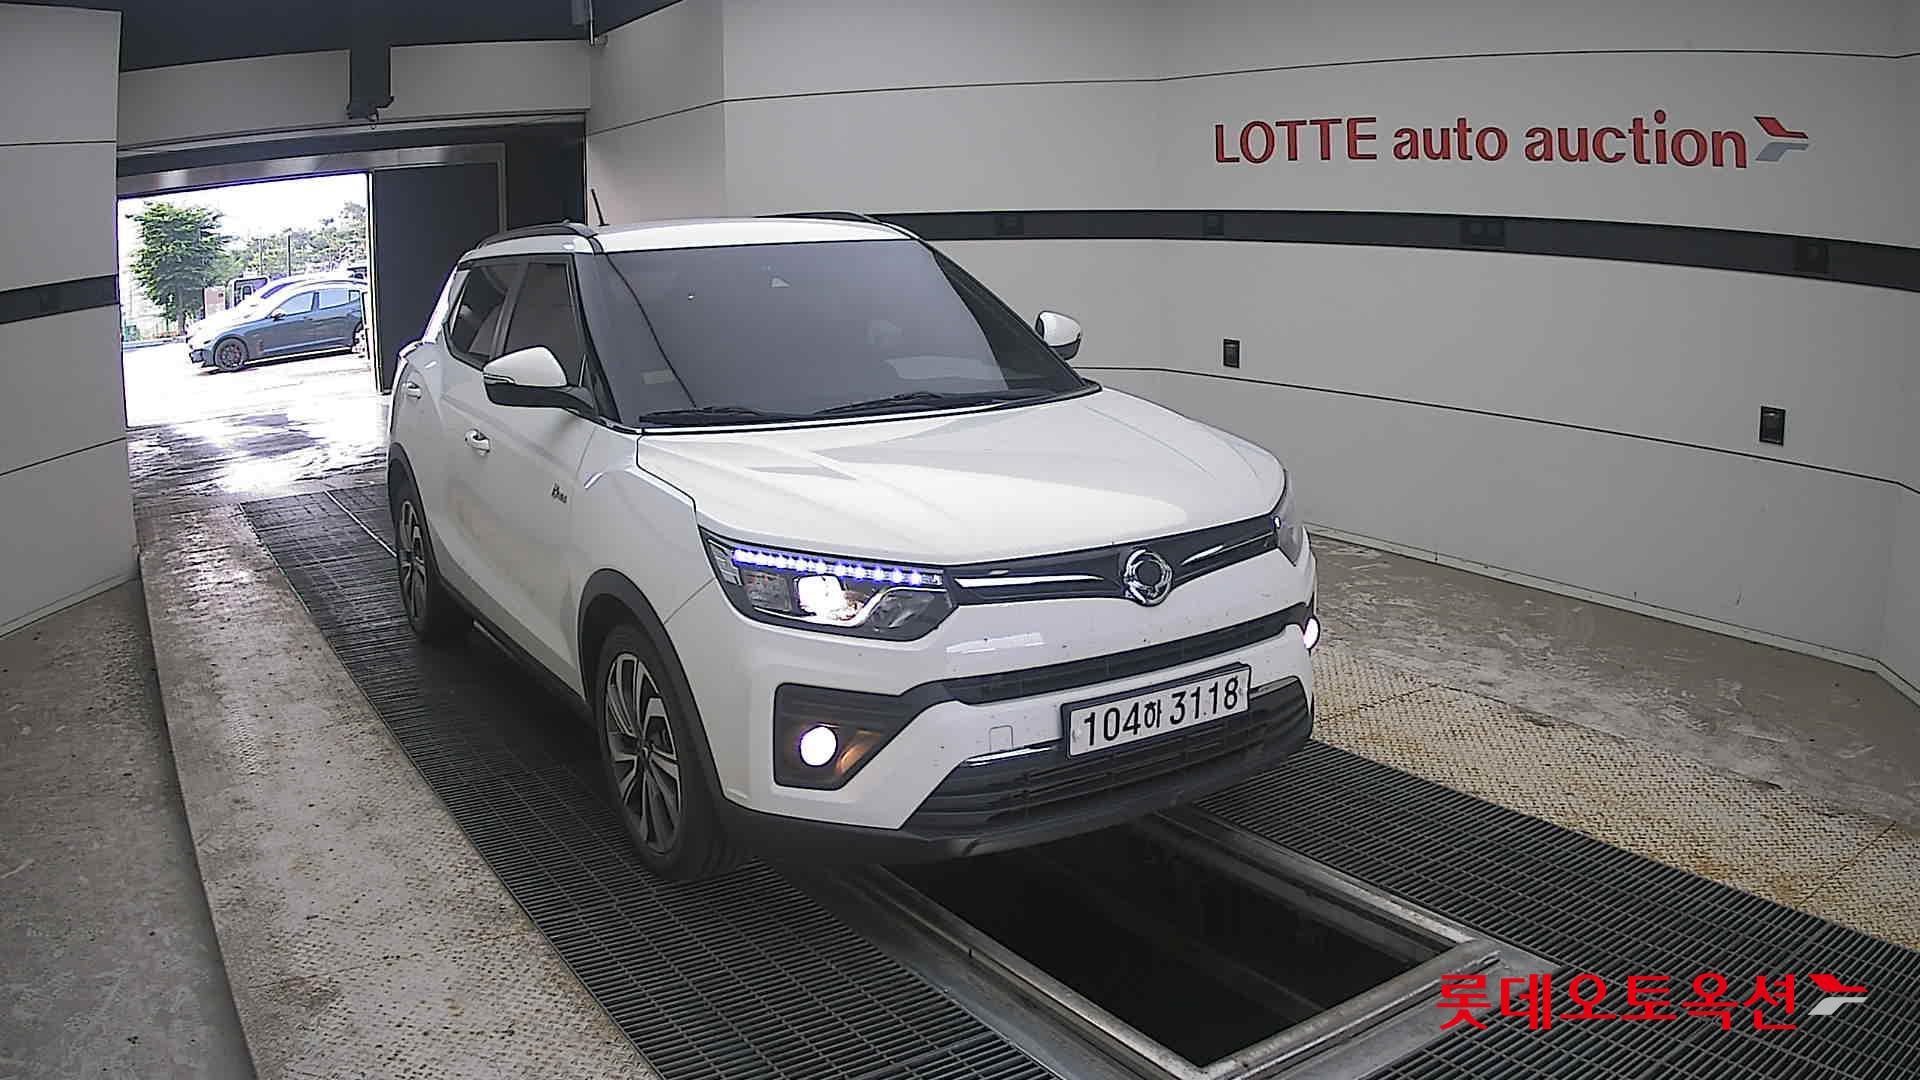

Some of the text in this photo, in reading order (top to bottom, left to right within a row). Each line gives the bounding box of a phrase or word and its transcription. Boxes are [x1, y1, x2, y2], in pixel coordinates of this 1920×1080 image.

[1214, 109, 1748, 169] LOTTE auto auction
[1083, 675, 1240, 747] 104하 3118
